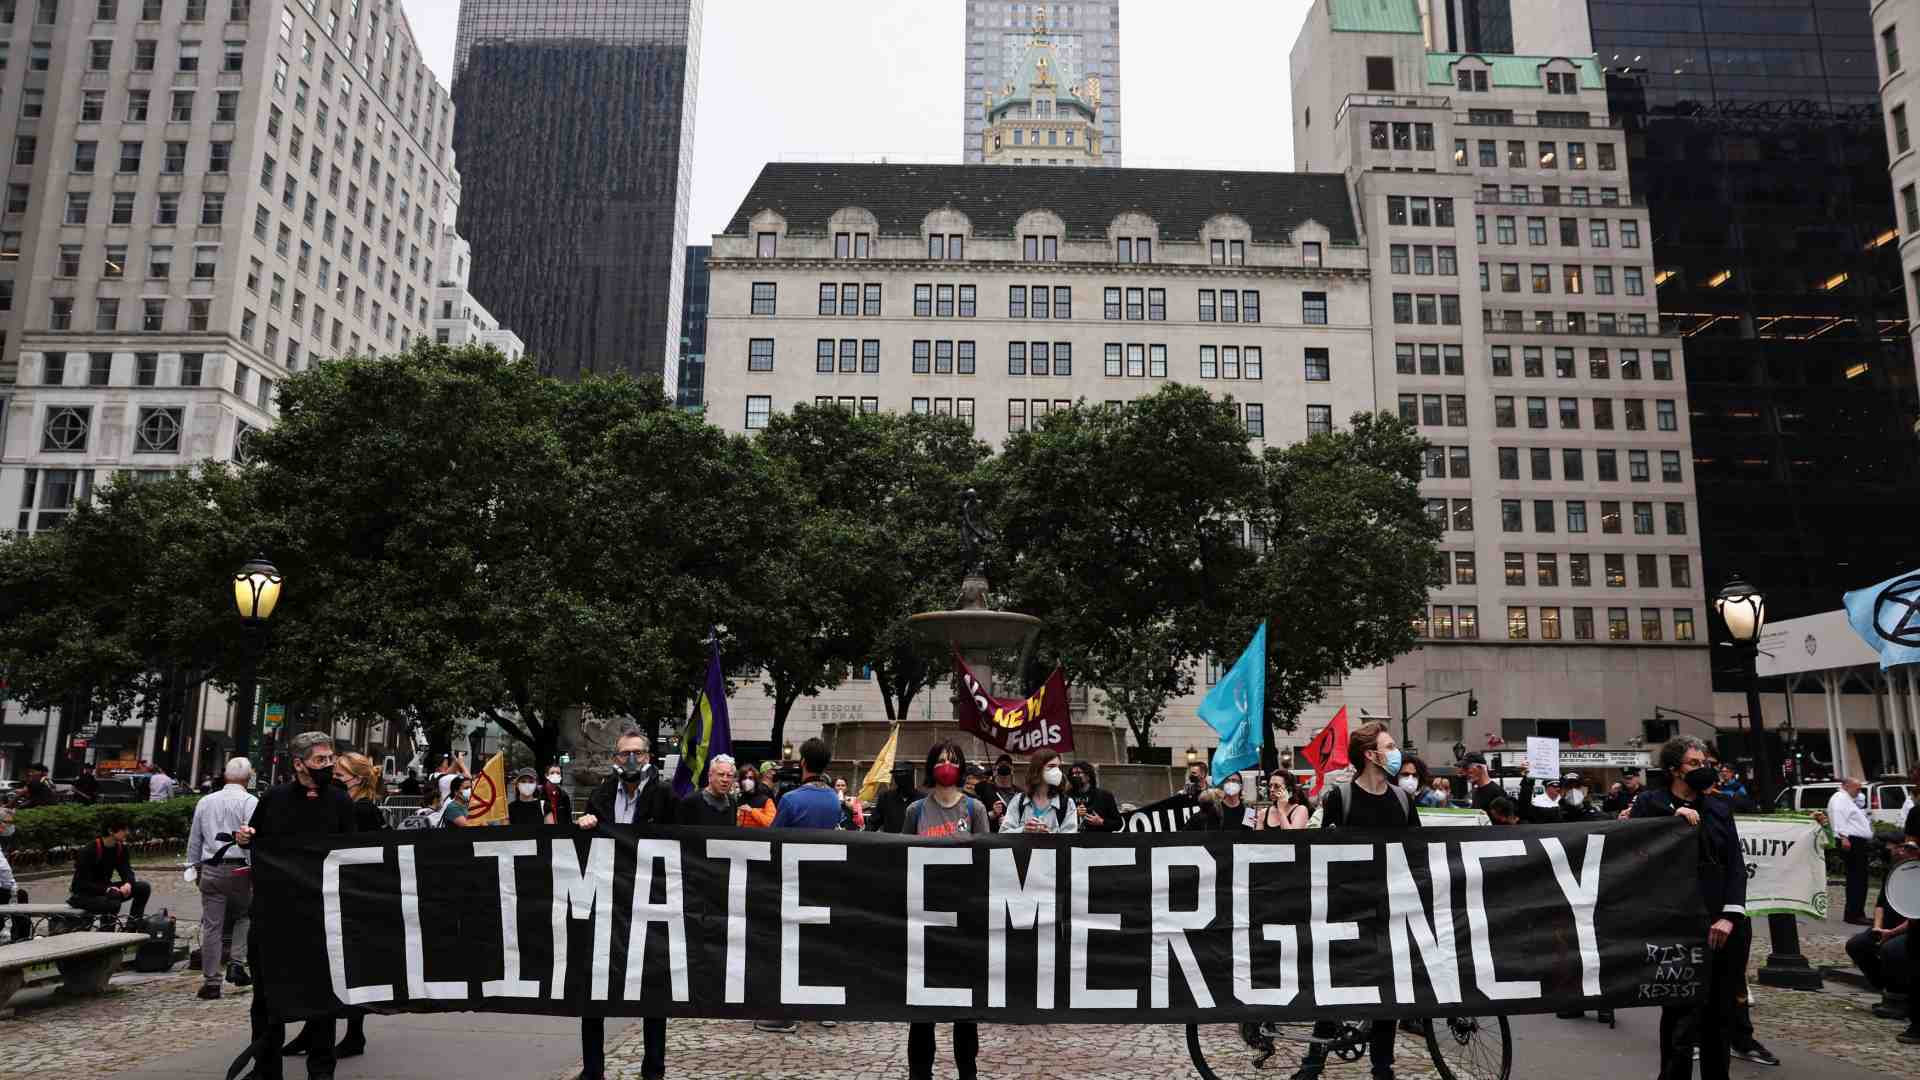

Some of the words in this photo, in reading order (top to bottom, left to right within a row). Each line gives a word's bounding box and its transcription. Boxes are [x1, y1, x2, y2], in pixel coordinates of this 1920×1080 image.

[993, 685, 1046, 728] NEW
[1005, 719, 1062, 751] Fuels
[322, 838, 848, 1005] CLIMATE
[905, 834, 1606, 1010] EMERGENCY
[1646, 943, 1704, 964] RISE
[1656, 966, 1695, 980] AND
[1638, 982, 1702, 999] RESIST
